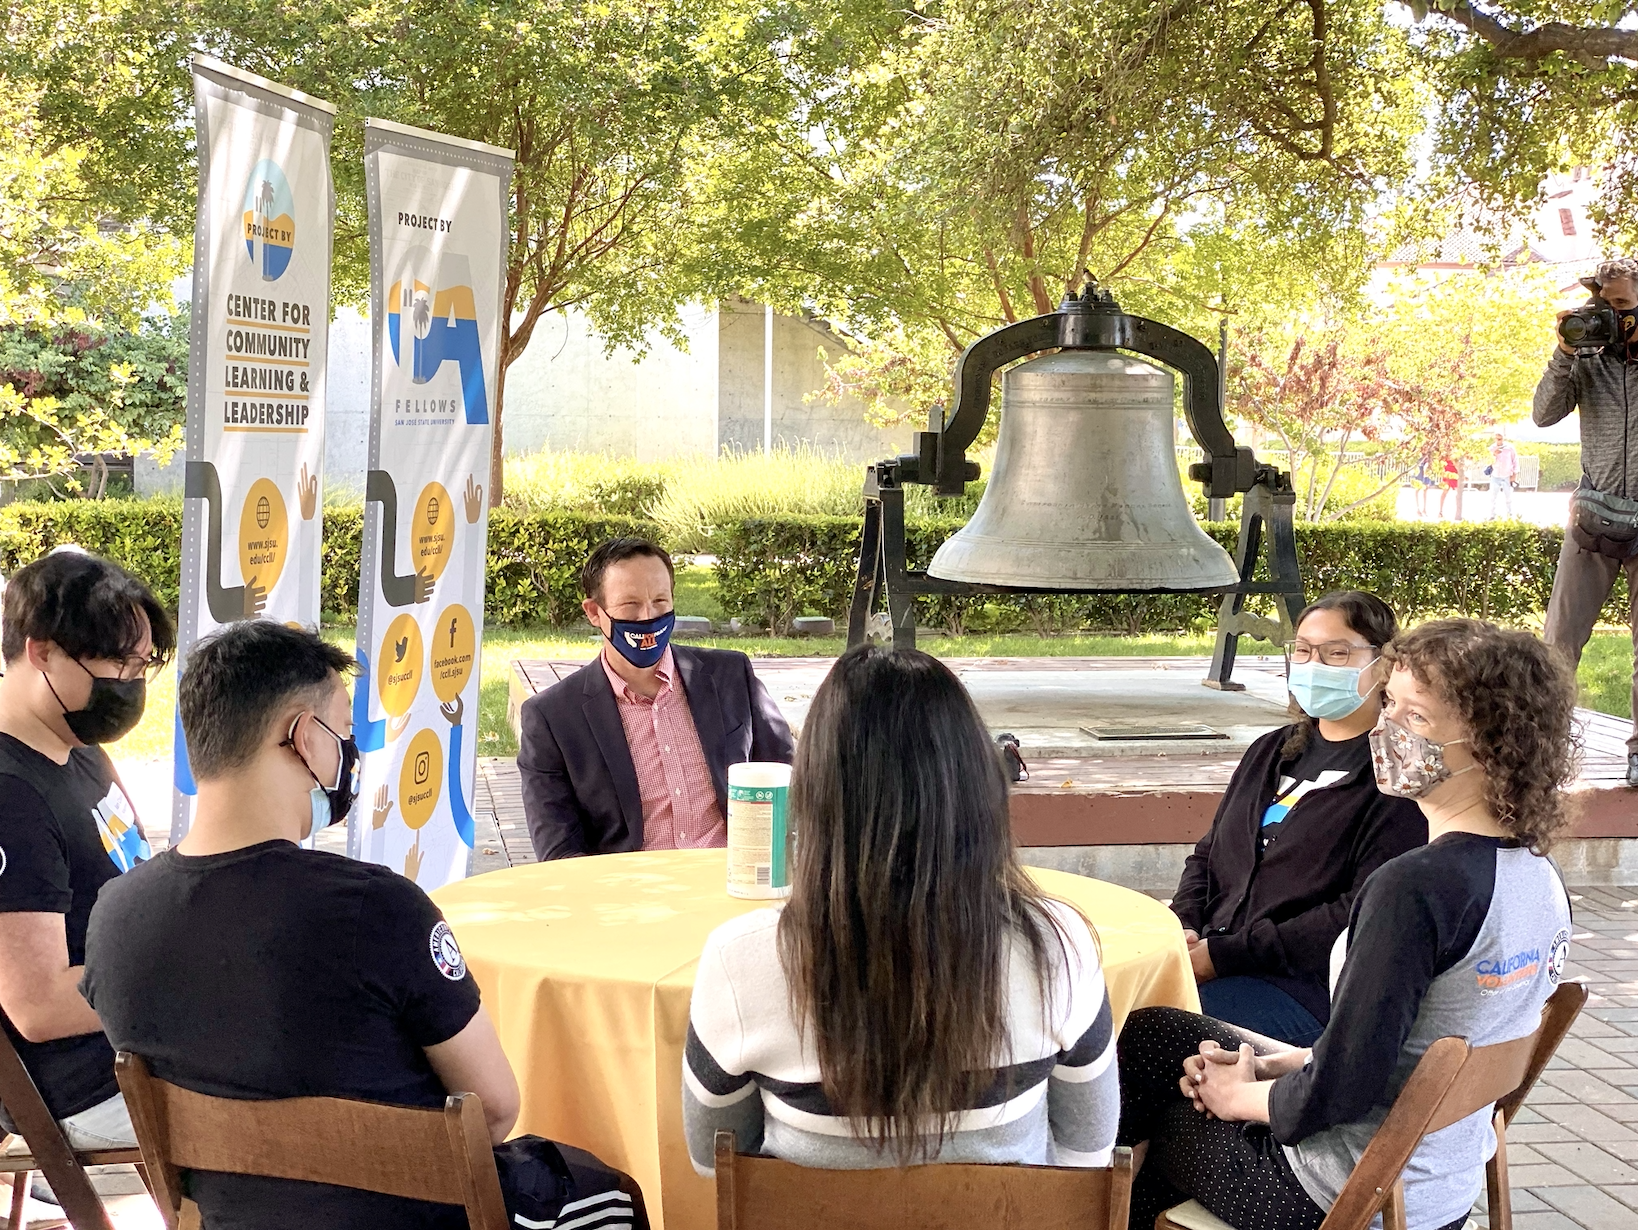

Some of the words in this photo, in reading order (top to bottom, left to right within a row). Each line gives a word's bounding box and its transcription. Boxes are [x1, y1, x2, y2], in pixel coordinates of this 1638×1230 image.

[398, 212, 438, 231] PROJECT
[440, 219, 452, 233] BY
[247, 223, 279, 240] PROJECT
[281, 230, 292, 242] BY
[226, 293, 277, 322] CENTER
[282, 302, 311, 326] FOR
[226, 329, 310, 359] COMMUNITY
[225, 365, 295, 391] LEARNING
[299, 371, 310, 392] &
[224, 401, 309, 425] LEADERSHIP
[395, 399, 456, 413] FELLOWS
[394, 419, 405, 427] SAN
[430, 418, 455, 426] UNIVERSITY
[247, 537, 278, 551] www.sjsu.
[419, 532, 445, 544] www.sjsu.
[249, 552, 276, 565] edu/ccll/
[433, 654, 471, 669] facebook.com
[388, 670, 413, 685] @sjsuccll
[439, 667, 463, 680] /ccll.sjsu
